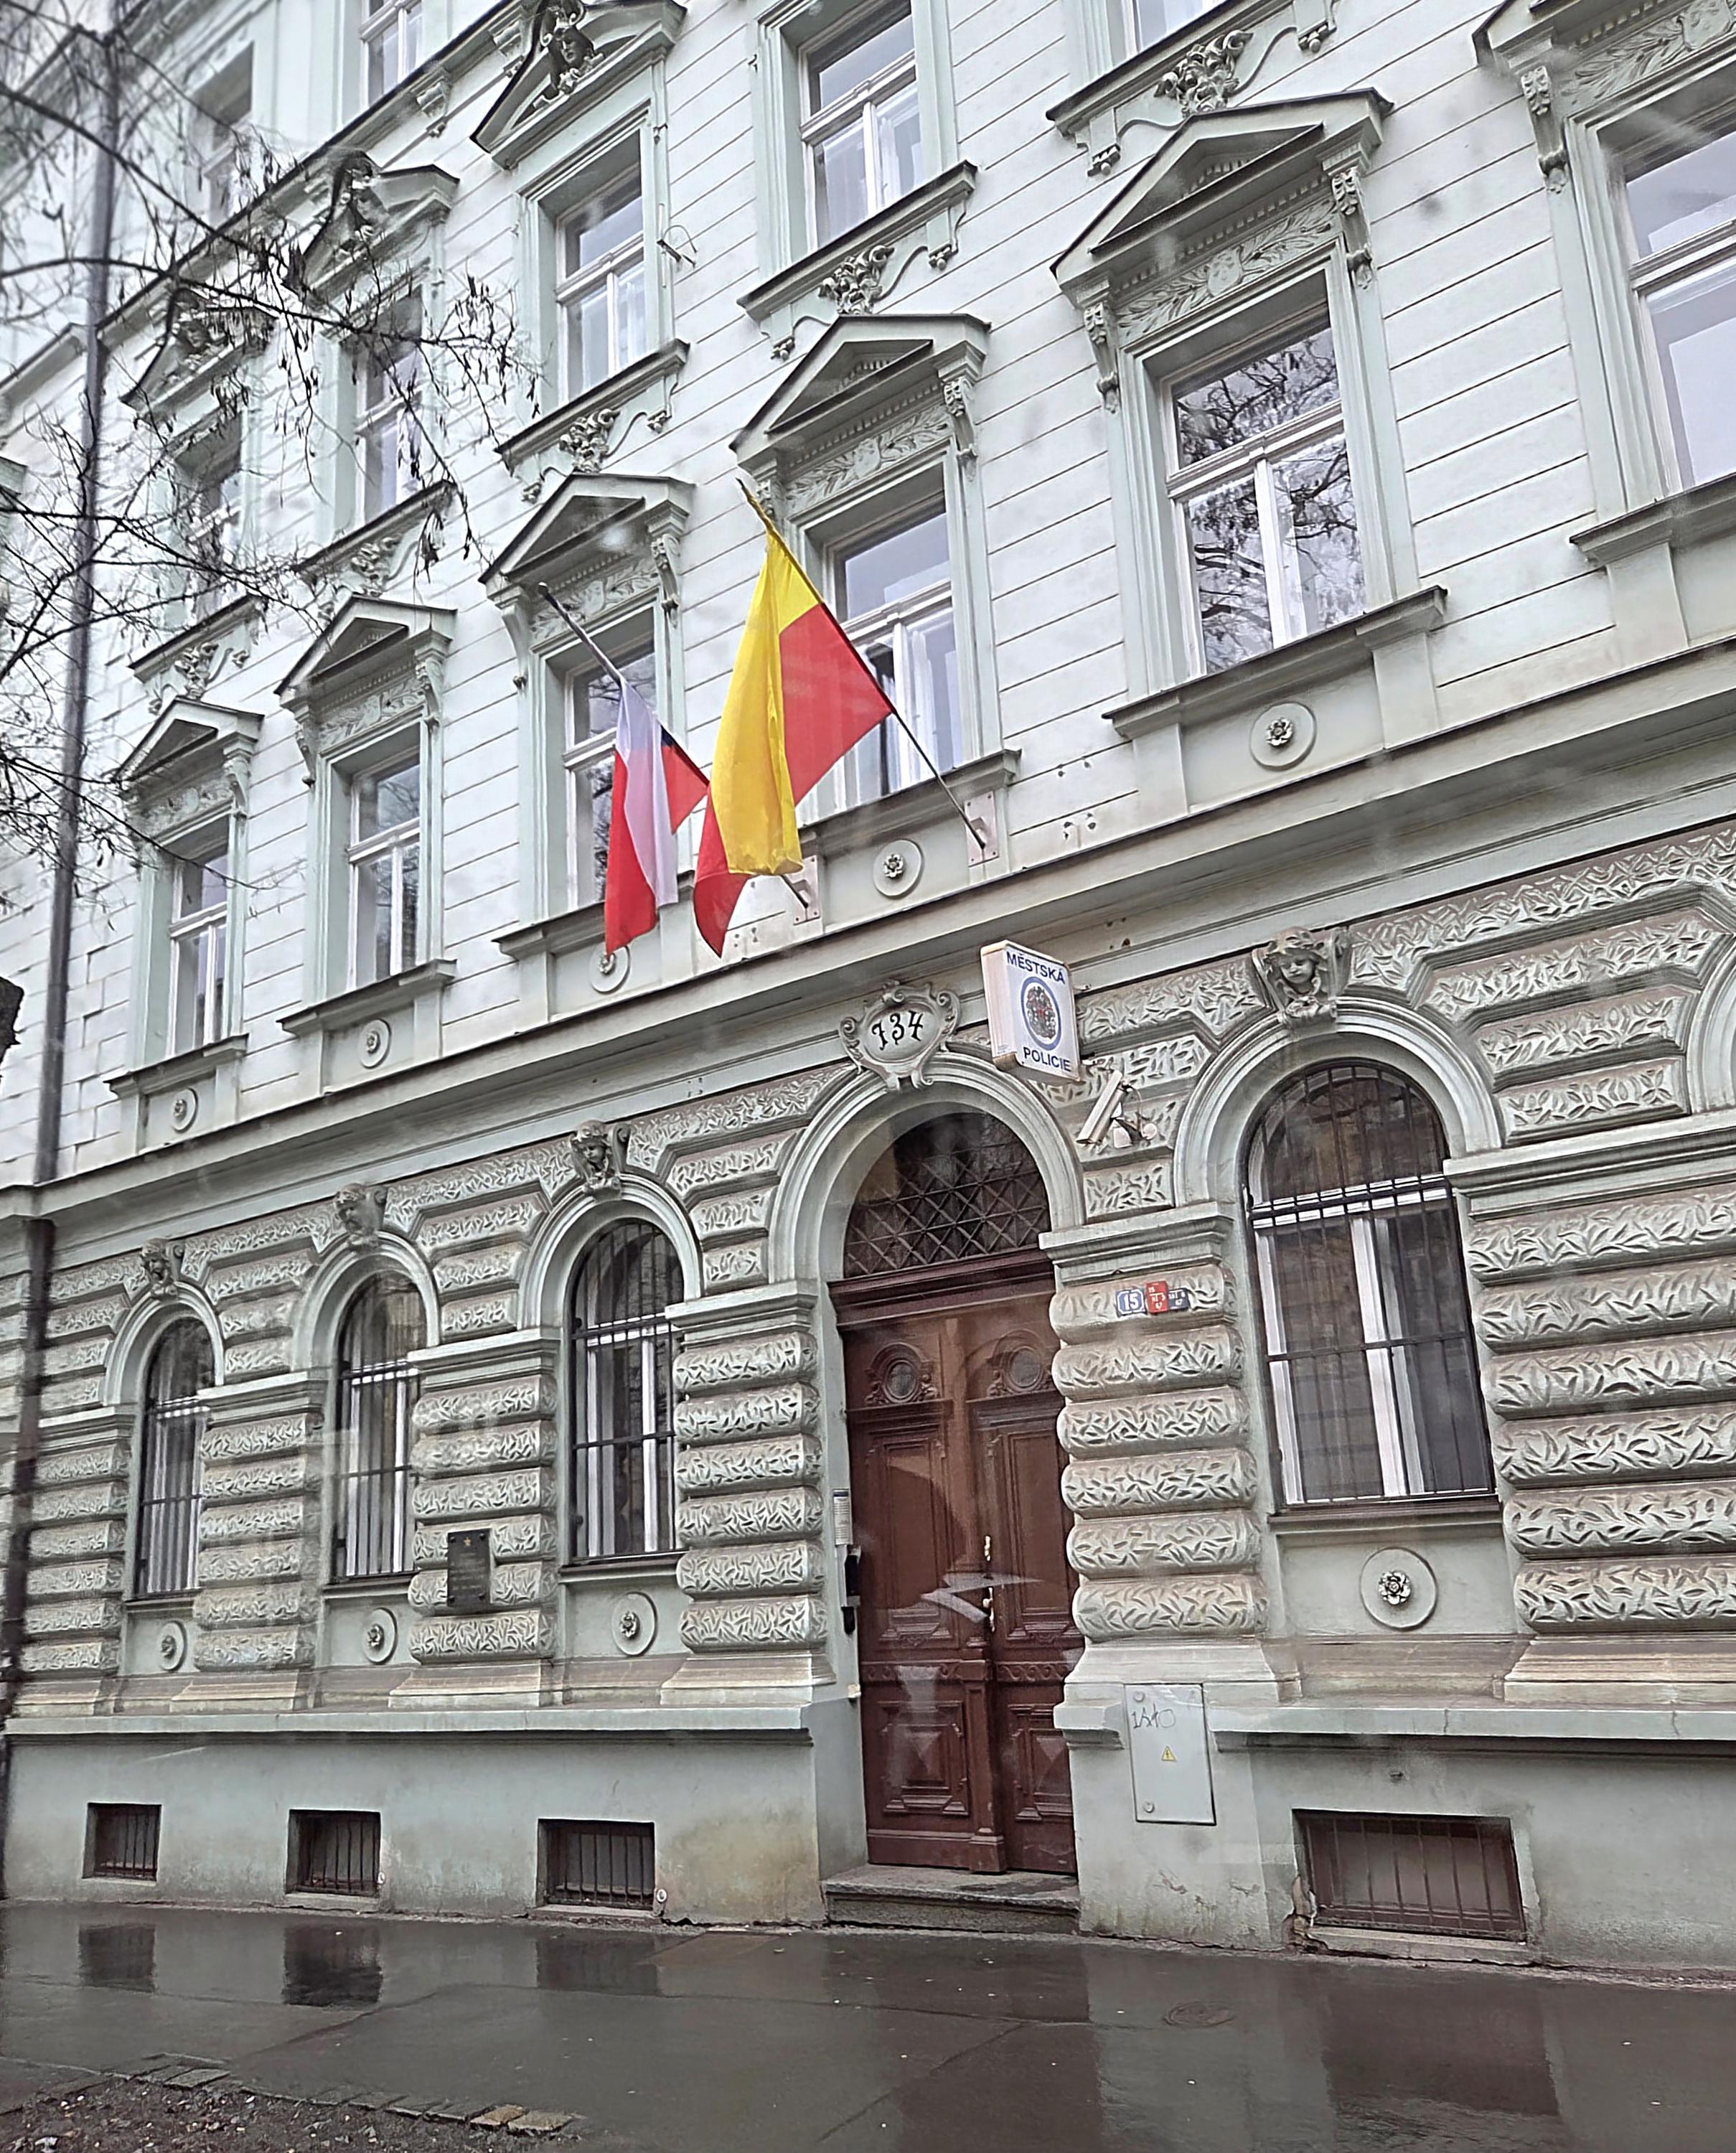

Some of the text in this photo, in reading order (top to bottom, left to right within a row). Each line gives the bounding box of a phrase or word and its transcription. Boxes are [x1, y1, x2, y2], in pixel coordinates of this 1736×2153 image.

[1006, 951, 1066, 985] MĚSTSKÁ
[1023, 1046, 1072, 1073] POLICIE
[1124, 1293, 1140, 1310] 15
